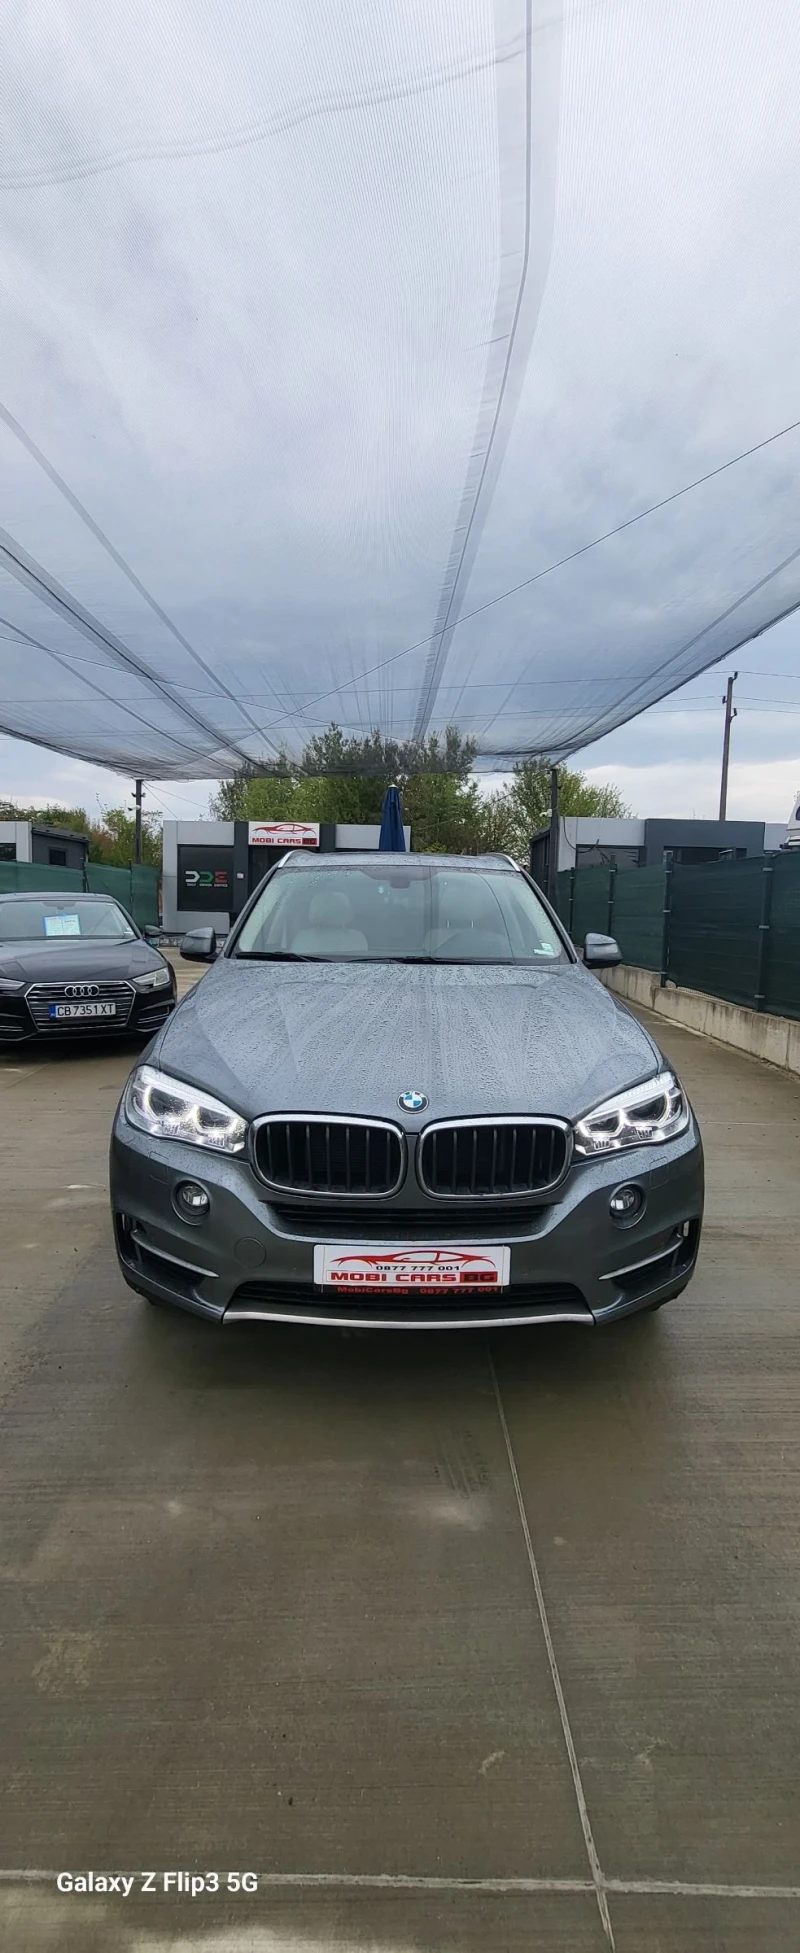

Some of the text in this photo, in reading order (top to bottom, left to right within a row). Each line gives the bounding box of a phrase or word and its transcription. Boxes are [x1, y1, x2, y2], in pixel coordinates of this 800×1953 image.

[57, 1004, 113, 1016] CB 7351 XT
[330, 1272, 495, 1282] MOBI CARS BG
